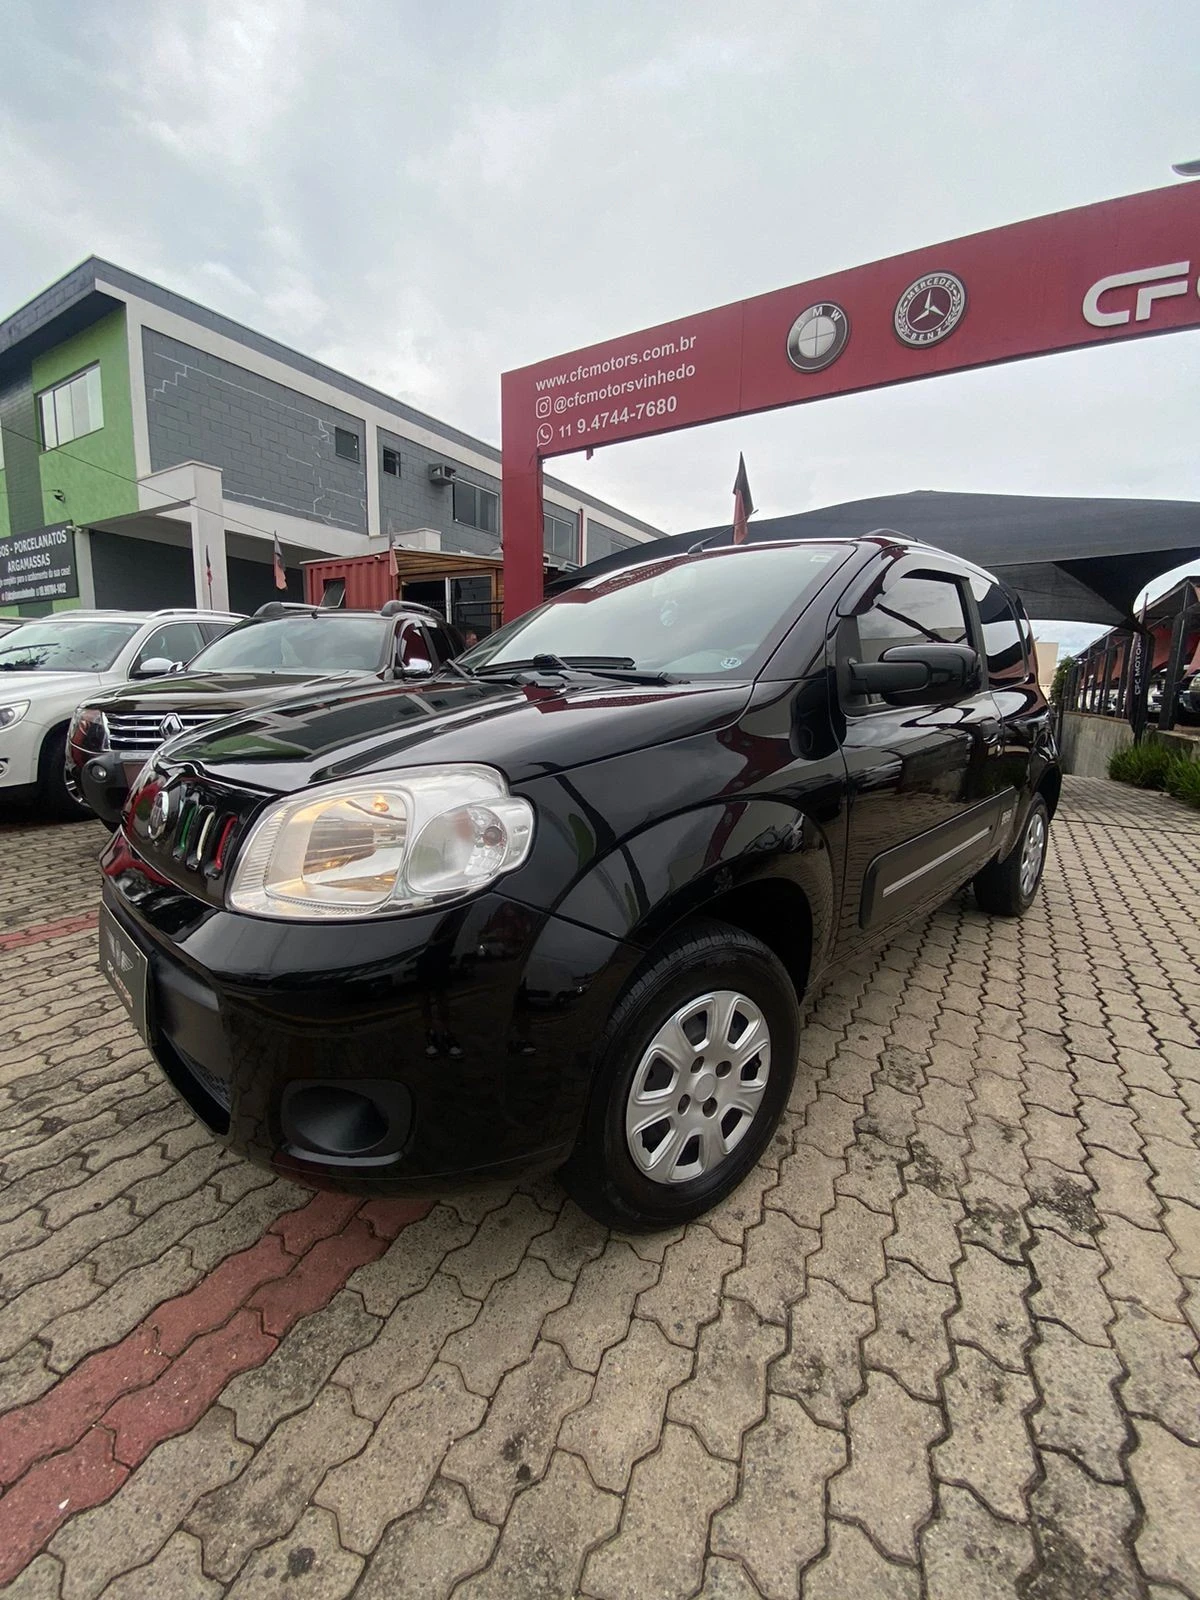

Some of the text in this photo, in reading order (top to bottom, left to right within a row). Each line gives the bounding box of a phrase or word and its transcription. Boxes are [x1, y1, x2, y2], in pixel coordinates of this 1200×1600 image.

[906, 277, 955, 301] MERCEDES
[1083, 261, 1200, 327] CF
[910, 328, 942, 341] BENZ
[535, 334, 697, 392] www.cfcmotors.com.br
[554, 362, 697, 414] @cfcmotorsvinhedo
[558, 395, 678, 438] 11 9.4744-7680
[14, 530, 67, 553] PORCELANATOS
[8, 553, 50, 573] ARGAMASSAS
